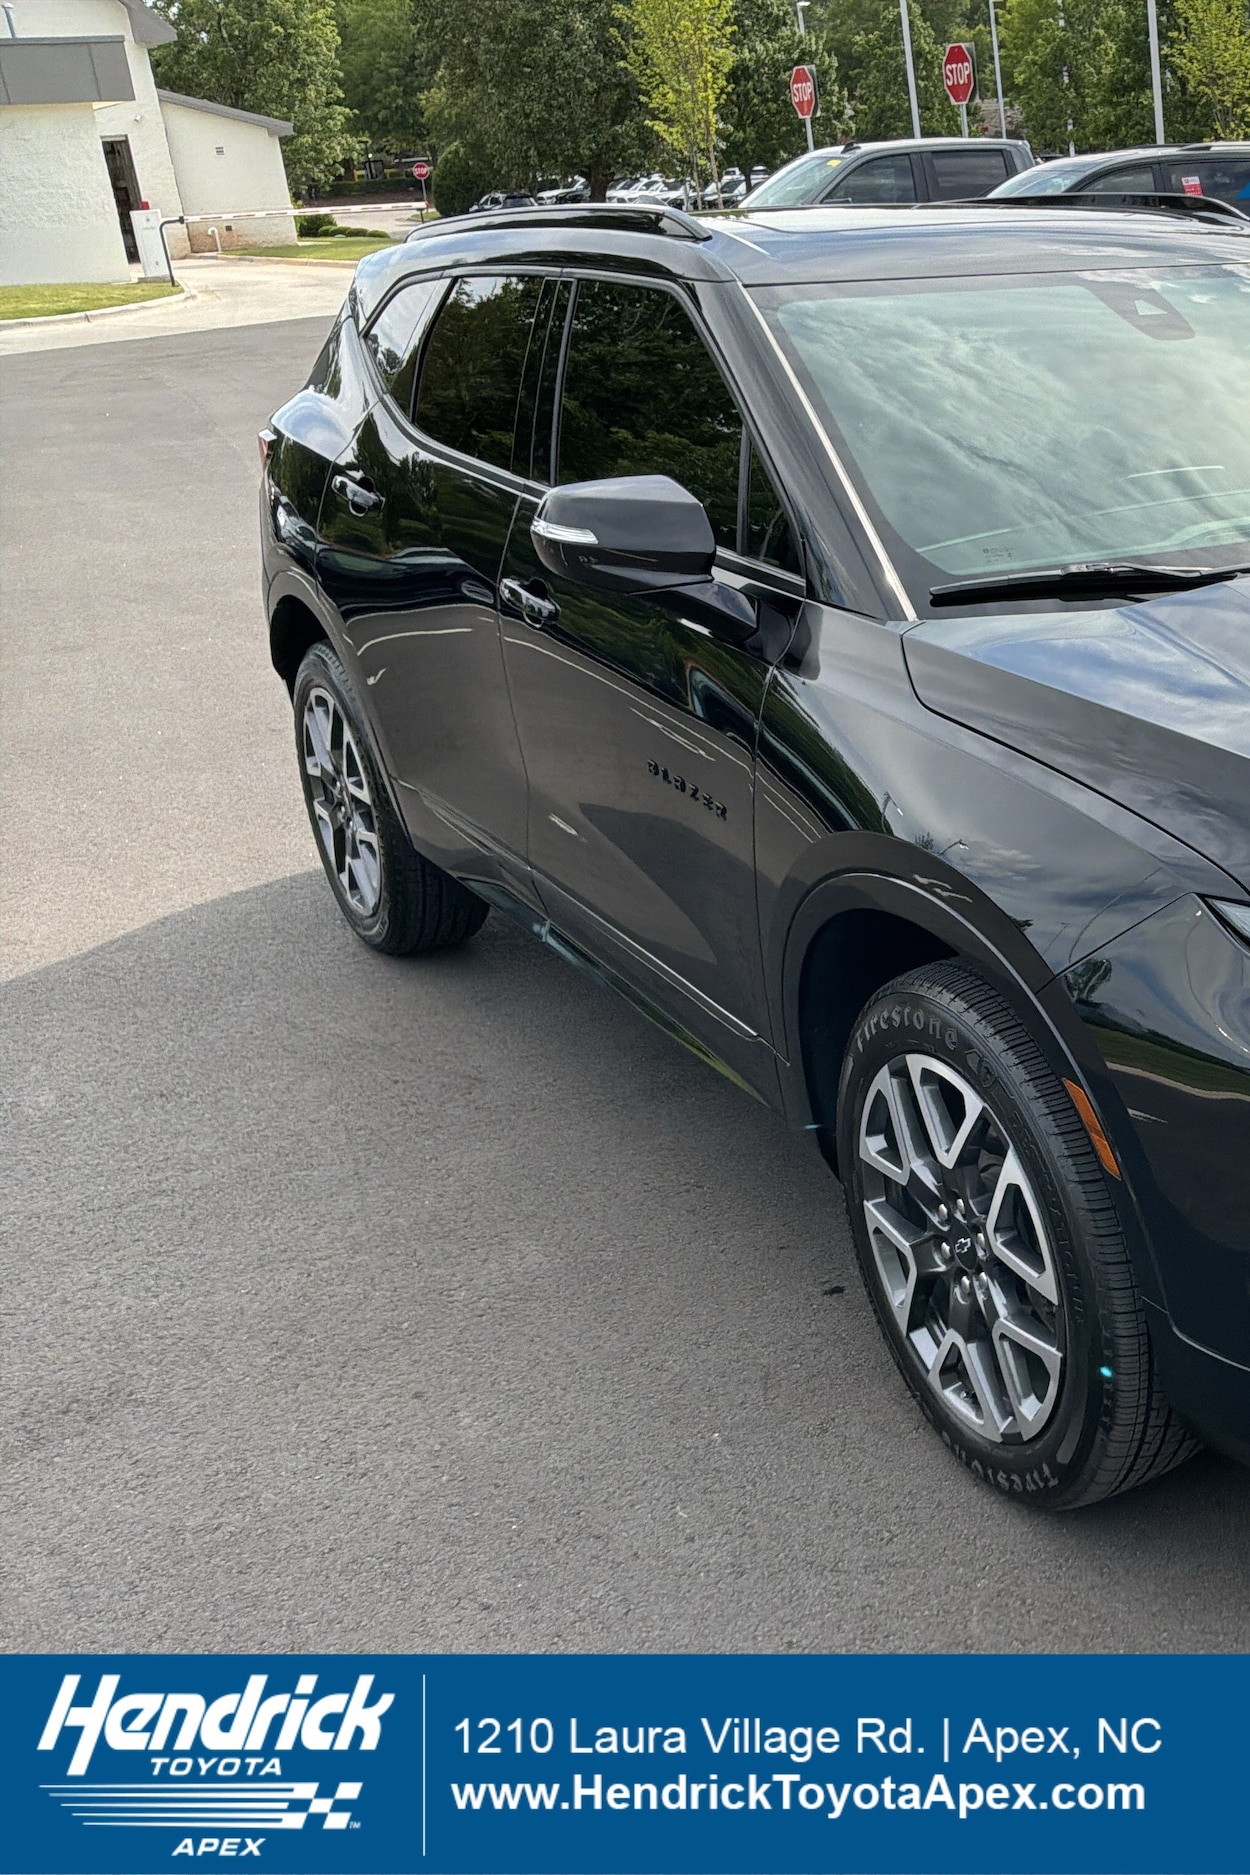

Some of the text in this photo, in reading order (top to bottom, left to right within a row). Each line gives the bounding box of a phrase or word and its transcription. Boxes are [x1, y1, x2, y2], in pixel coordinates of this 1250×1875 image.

[792, 81, 812, 103] STOP
[945, 61, 970, 87] STOP
[646, 759, 728, 821] BLAZER
[855, 1001, 960, 1053] Firestone
